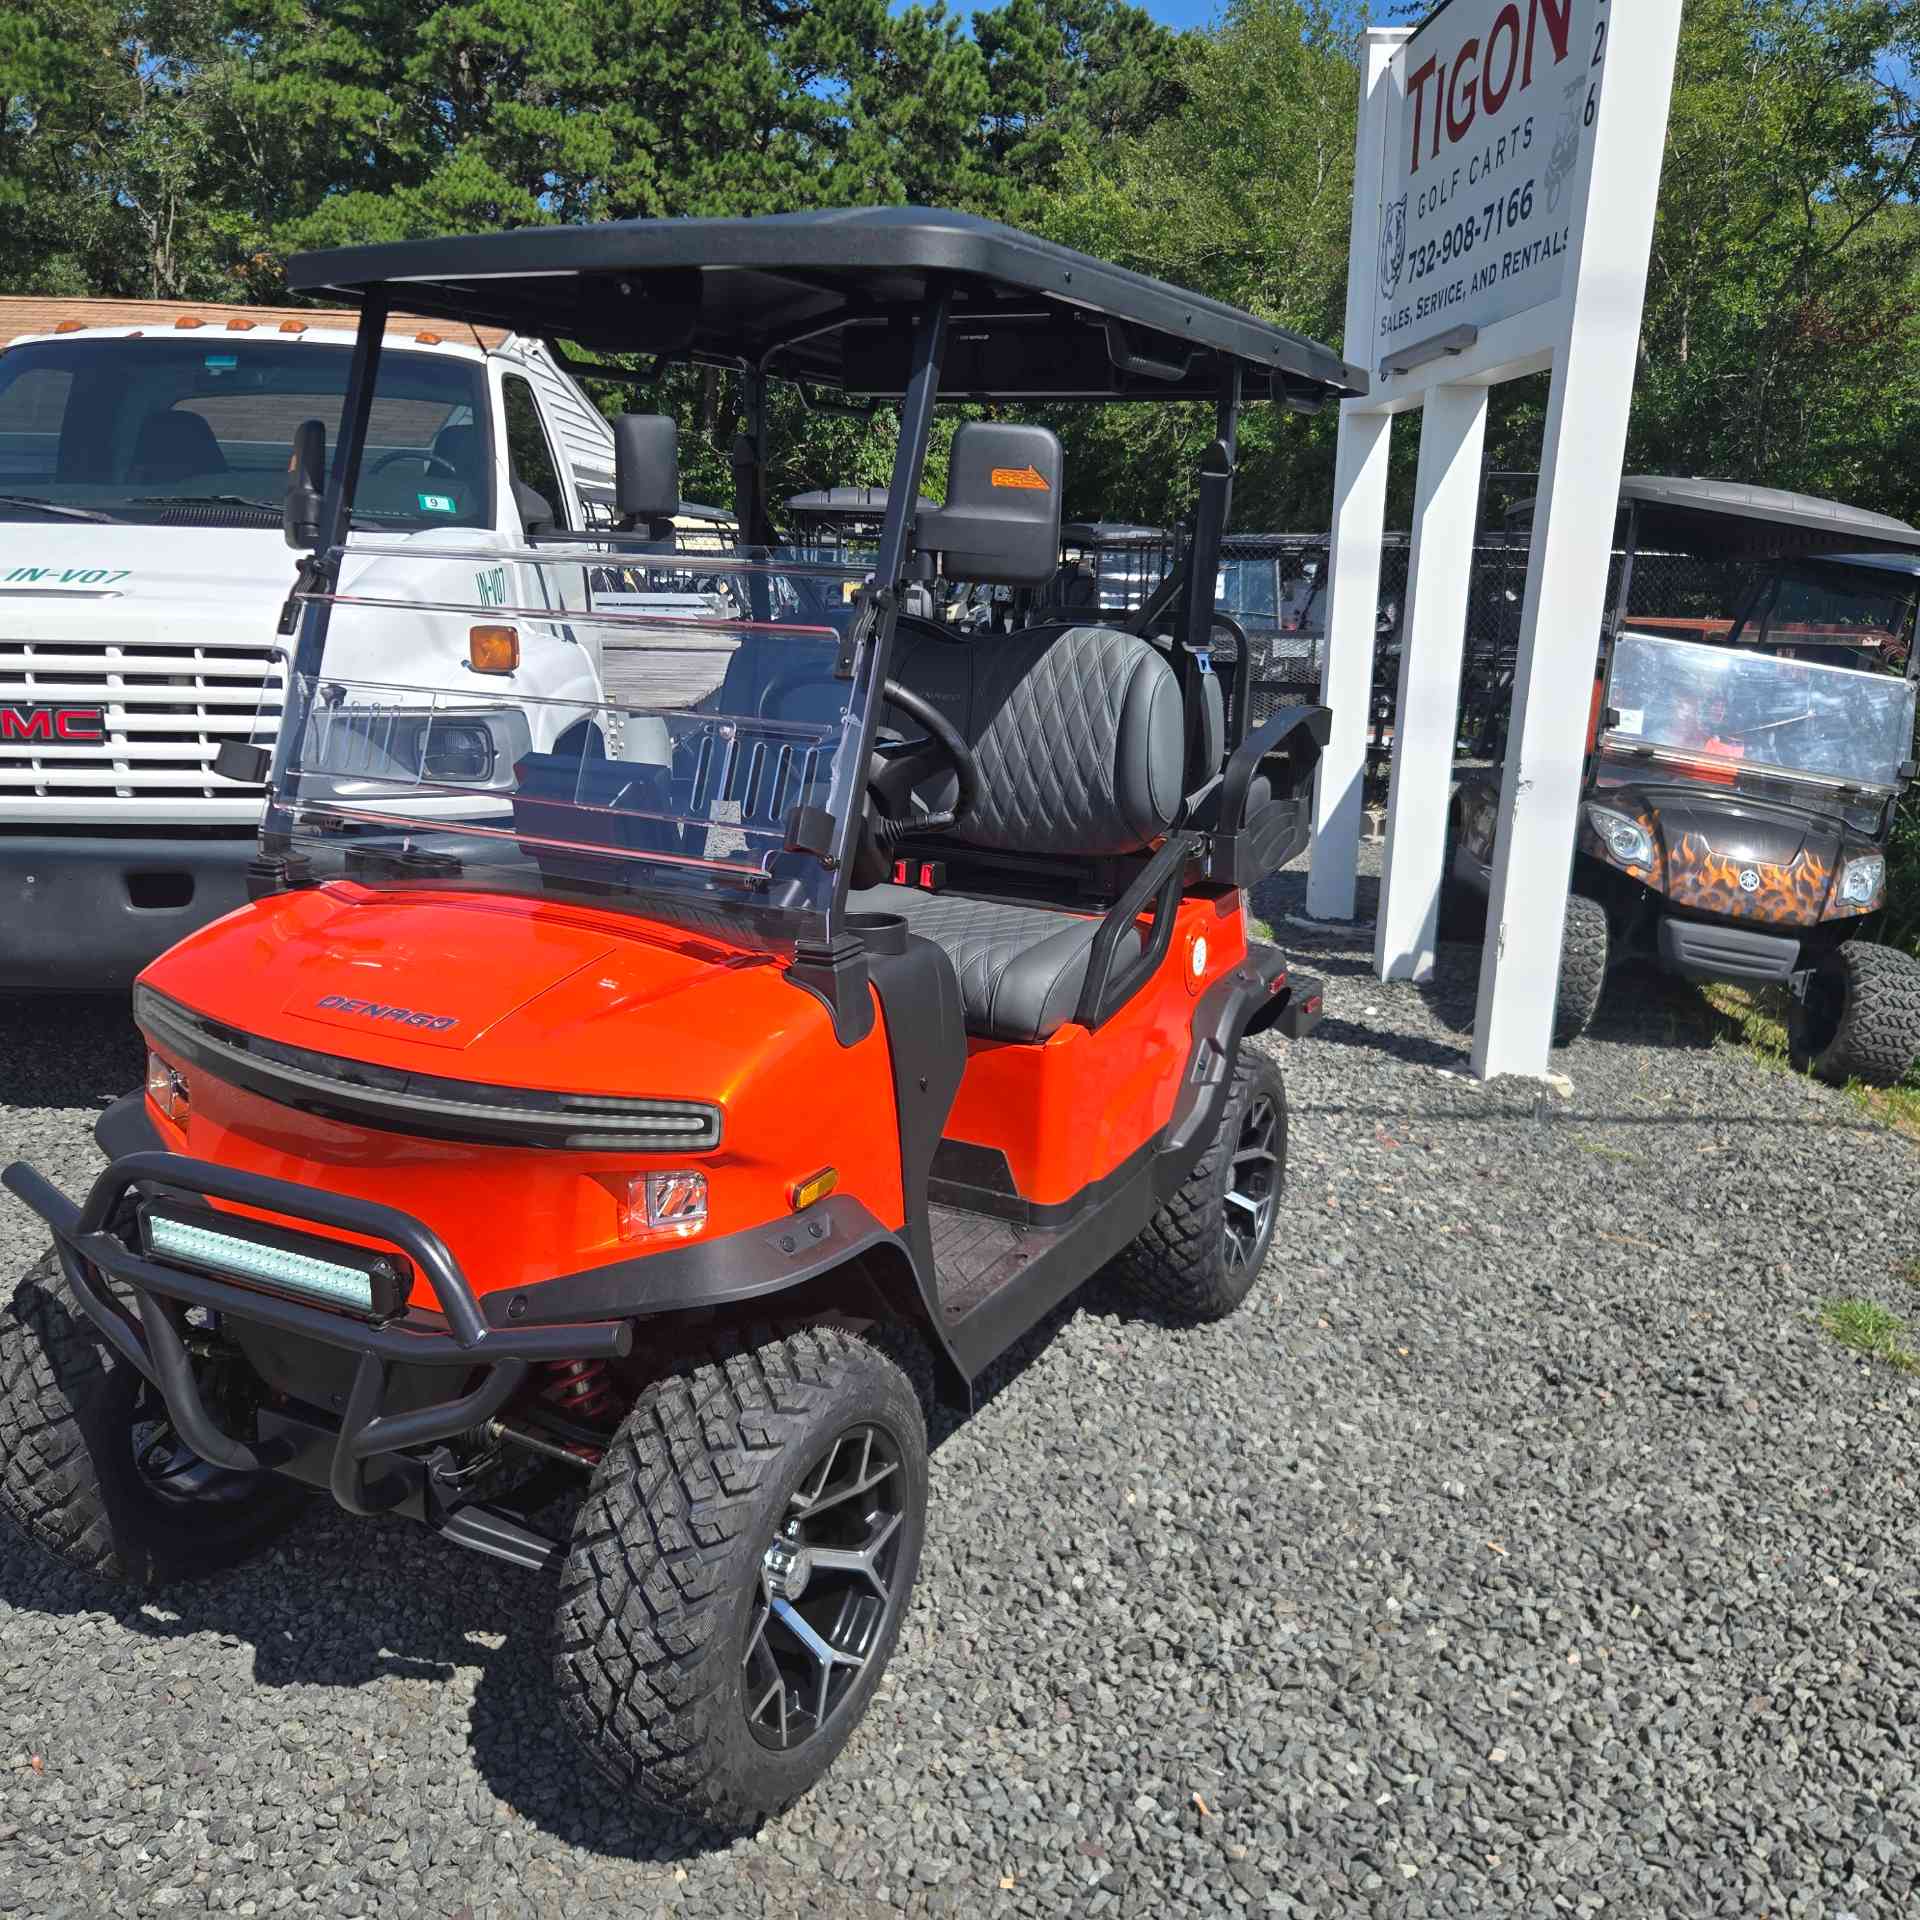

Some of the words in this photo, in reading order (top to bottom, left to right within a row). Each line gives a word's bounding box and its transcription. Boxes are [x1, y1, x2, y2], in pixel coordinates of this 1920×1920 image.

[1407, 0, 1572, 176] TIGON
[1418, 168, 1460, 219] GOLF
[1469, 116, 1534, 185] CARTS
[1408, 179, 1535, 284] 732-908-7166
[1380, 307, 1413, 337] SALES,
[1416, 280, 1466, 320] SERVICE,
[1471, 263, 1497, 295] AND
[0, 708, 103, 740] MC
[317, 994, 459, 1030] DENAGO
